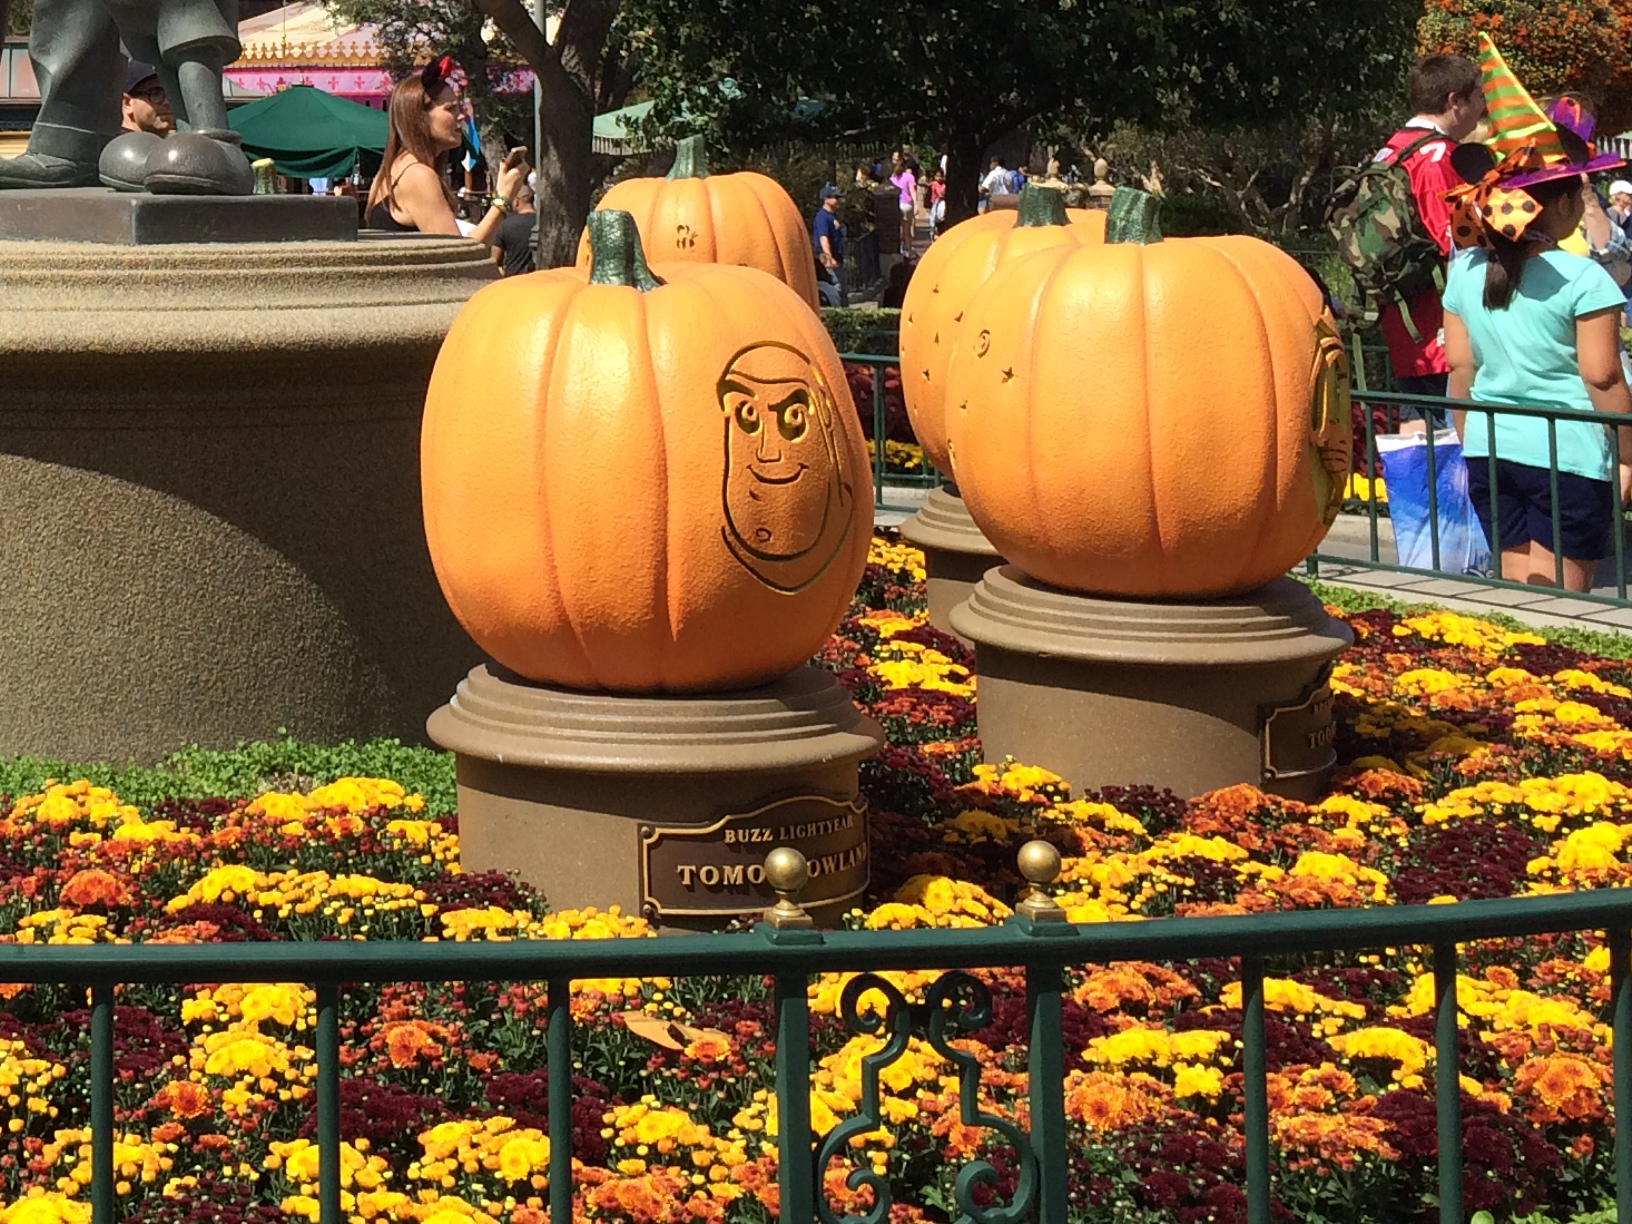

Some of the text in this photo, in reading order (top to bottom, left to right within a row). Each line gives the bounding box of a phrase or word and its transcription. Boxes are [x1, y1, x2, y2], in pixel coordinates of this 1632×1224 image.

[724, 814, 854, 844] BUZZ LIGHTYEAR
[677, 842, 867, 886] TOMOOWLAND
